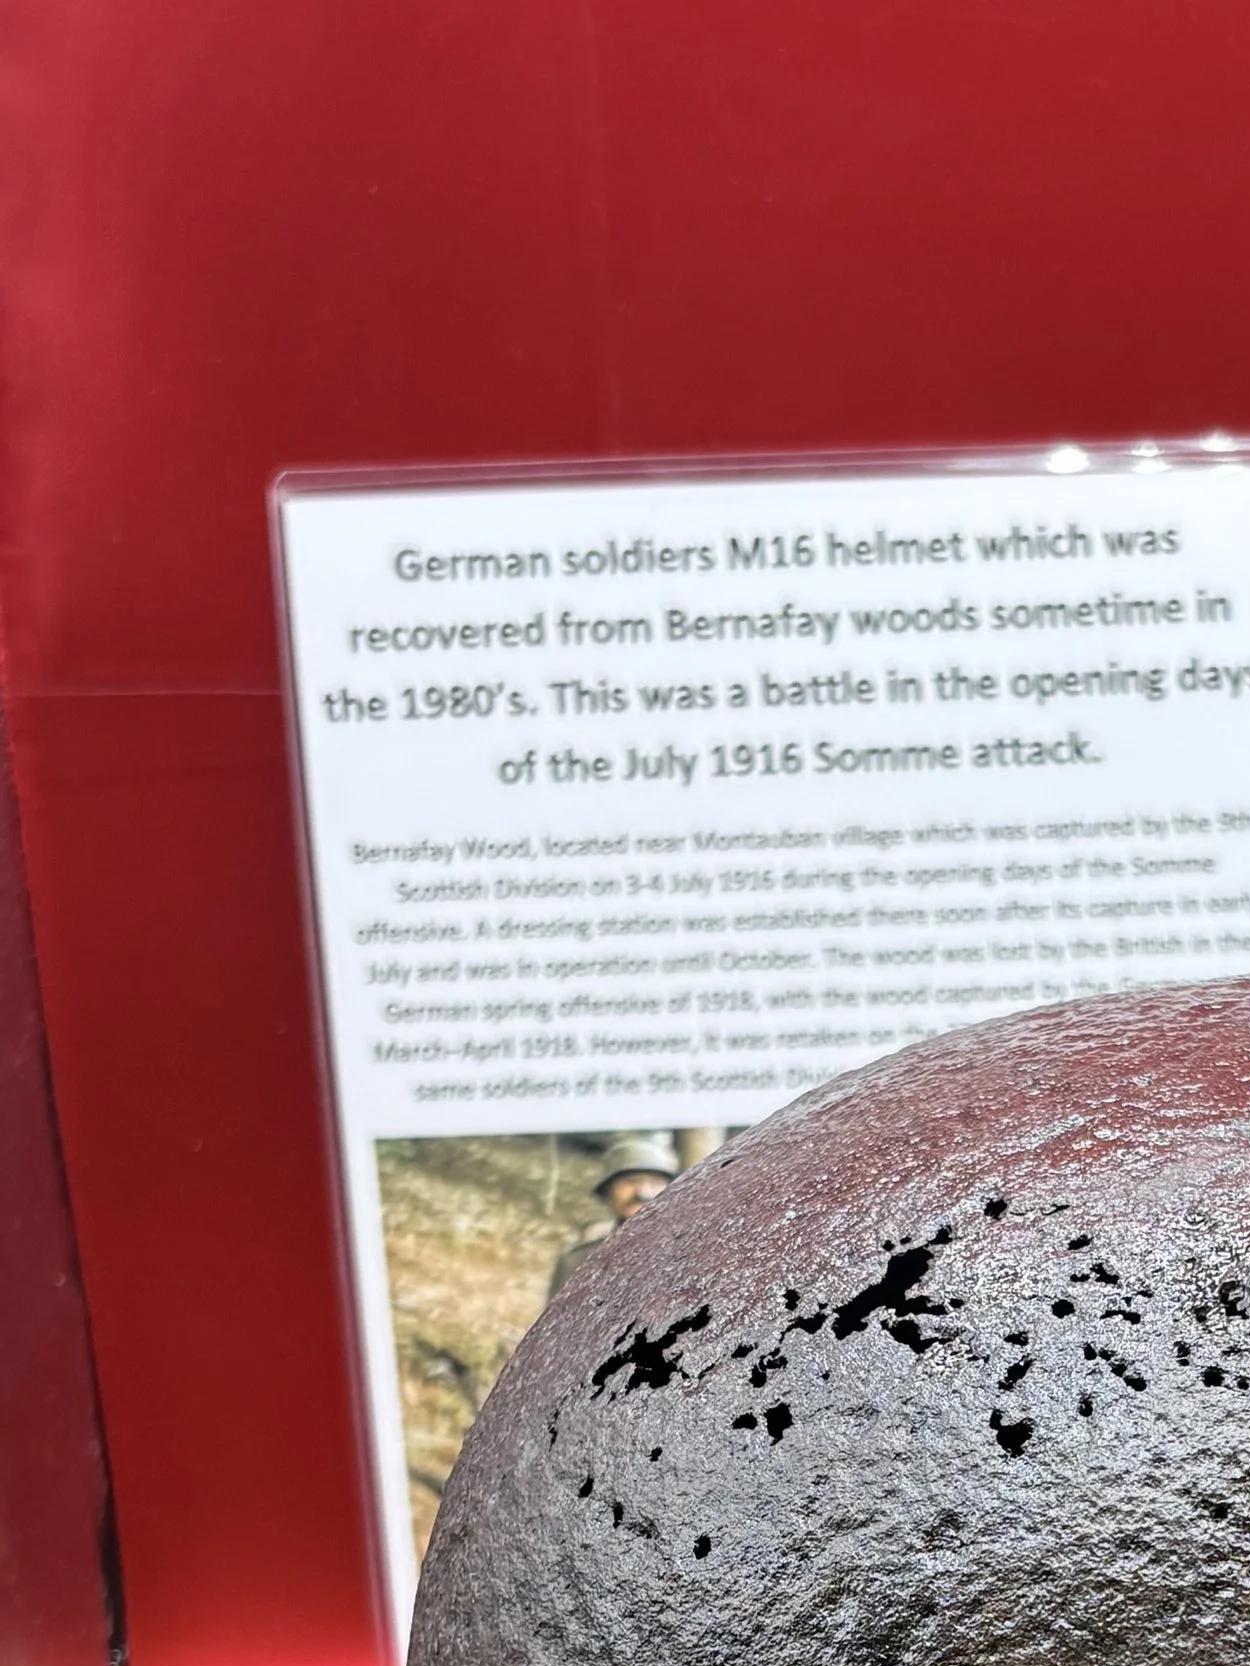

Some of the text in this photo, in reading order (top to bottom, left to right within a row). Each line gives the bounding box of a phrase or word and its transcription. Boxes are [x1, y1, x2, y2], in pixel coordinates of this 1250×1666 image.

[393, 524, 1180, 582] German soldiers M16 helmet which was
[349, 588, 1233, 652] recovered from Bernafay woods sometime in
[323, 688, 388, 723] the
[402, 683, 540, 720] 1980's.
[550, 679, 628, 715] This
[638, 684, 716, 711] was
[727, 682, 750, 709] a
[759, 671, 876, 707] battle
[885, 669, 924, 703] in
[933, 666, 999, 701] the
[1009, 662, 1167, 704] opening
[497, 731, 1103, 787] of the July 1916 Somme attack.
[349, 840, 455, 865] Bernafay
[460, 837, 537, 862] Wood,
[540, 834, 630, 857] located
[634, 836, 686, 854] near
[691, 829, 825, 851] Montauban
[832, 825, 904, 850] village
[911, 822, 976, 843] which
[984, 824, 1027, 841] was
[1034, 817, 1136, 841] captured
[1139, 815, 1168, 838] by
[1172, 813, 1211, 834] the
[395, 879, 490, 903] Scottish
[493, 877, 586, 900] Division
[590, 878, 622, 897] on
[669, 871, 713, 896] July
[718, 869, 776, 893] 1916
[781, 868, 854, 893] during
[859, 865, 898, 887] the
[904, 863, 995, 888] opening
[1002, 861, 1053, 883] days
[1060, 857, 1083, 880] of
[1086, 857, 1125, 878] the
[1131, 856, 1219, 877] Somme
[354, 921, 468, 945] offensive.
[474, 918, 491, 939] A
[497, 917, 593, 942] dressing
[597, 914, 677, 936] station
[682, 915, 727, 933] was
[732, 907, 862, 931] established
[867, 905, 928, 927] there
[934, 906, 988, 925] soon
[995, 899, 1049, 922] after
[1052, 899, 1082, 920] its
[1088, 898, 1174, 920] capture
[1178, 894, 1200, 914] in
[367, 961, 412, 987] July
[416, 960, 462, 983] and
[465, 962, 511, 980] was
[516, 957, 539, 979] in
[544, 955, 657, 980] operation
[661, 951, 715, 974] until
[822, 945, 865, 968] The
[872, 945, 937, 966] wood
[941, 946, 985, 963] was
[990, 941, 1032, 962] lost
[1035, 940, 1065, 962] by
[1069, 937, 1108, 959] the
[1112, 935, 1185, 957] British
[1189, 934, 1211, 954] in
[381, 1002, 478, 1024] German
[482, 998, 554, 1024] spring
[557, 994, 662, 1017] offensive
[668, 990, 693, 1015] of
[763, 988, 813, 1009] with
[821, 987, 859, 1008] the
[865, 984, 932, 1006] wood
[935, 981, 1036, 1005] captured
[1040, 980, 1068, 1002] by
[703, 1030, 721, 1052] it
[725, 1033, 770, 1051] was
[868, 1029, 896, 1047] on
[413, 1083, 477, 1102] same
[481, 1076, 570, 1099] soldiers
[574, 1072, 599, 1096] of
[603, 1073, 641, 1094] the
[647, 1071, 685, 1094] 9th
[690, 1069, 778, 1092] Scottish
